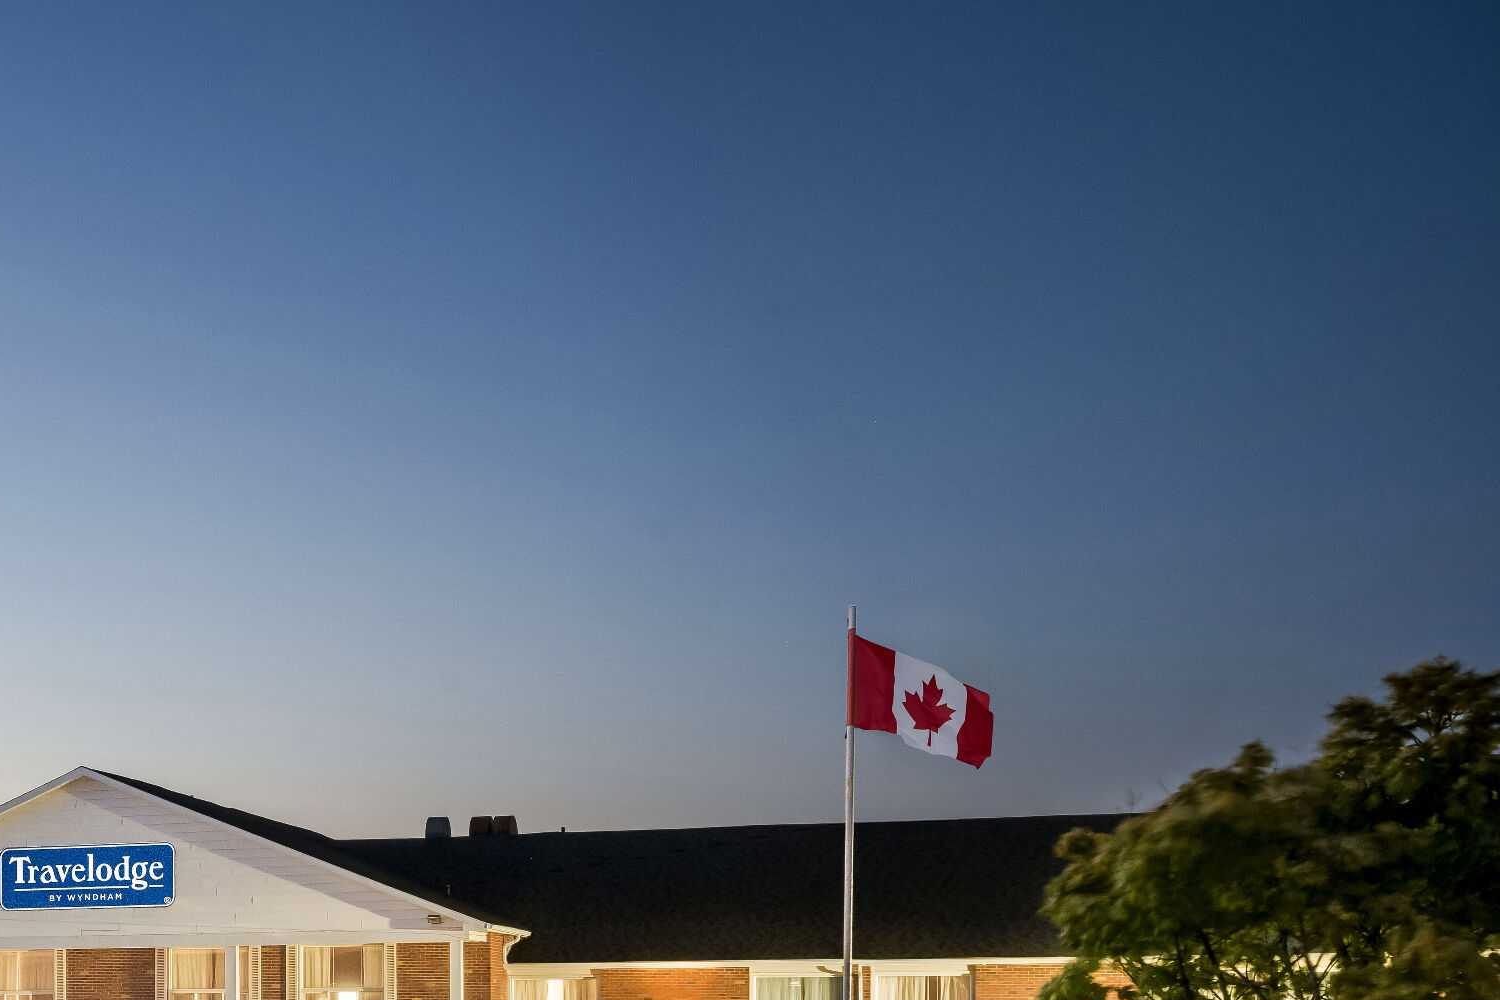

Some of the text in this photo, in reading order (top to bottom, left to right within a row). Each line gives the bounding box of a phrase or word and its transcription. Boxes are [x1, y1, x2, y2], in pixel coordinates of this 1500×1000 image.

[8, 854, 164, 890] Travelodge
[49, 893, 123, 902] BY WYNDHAM
